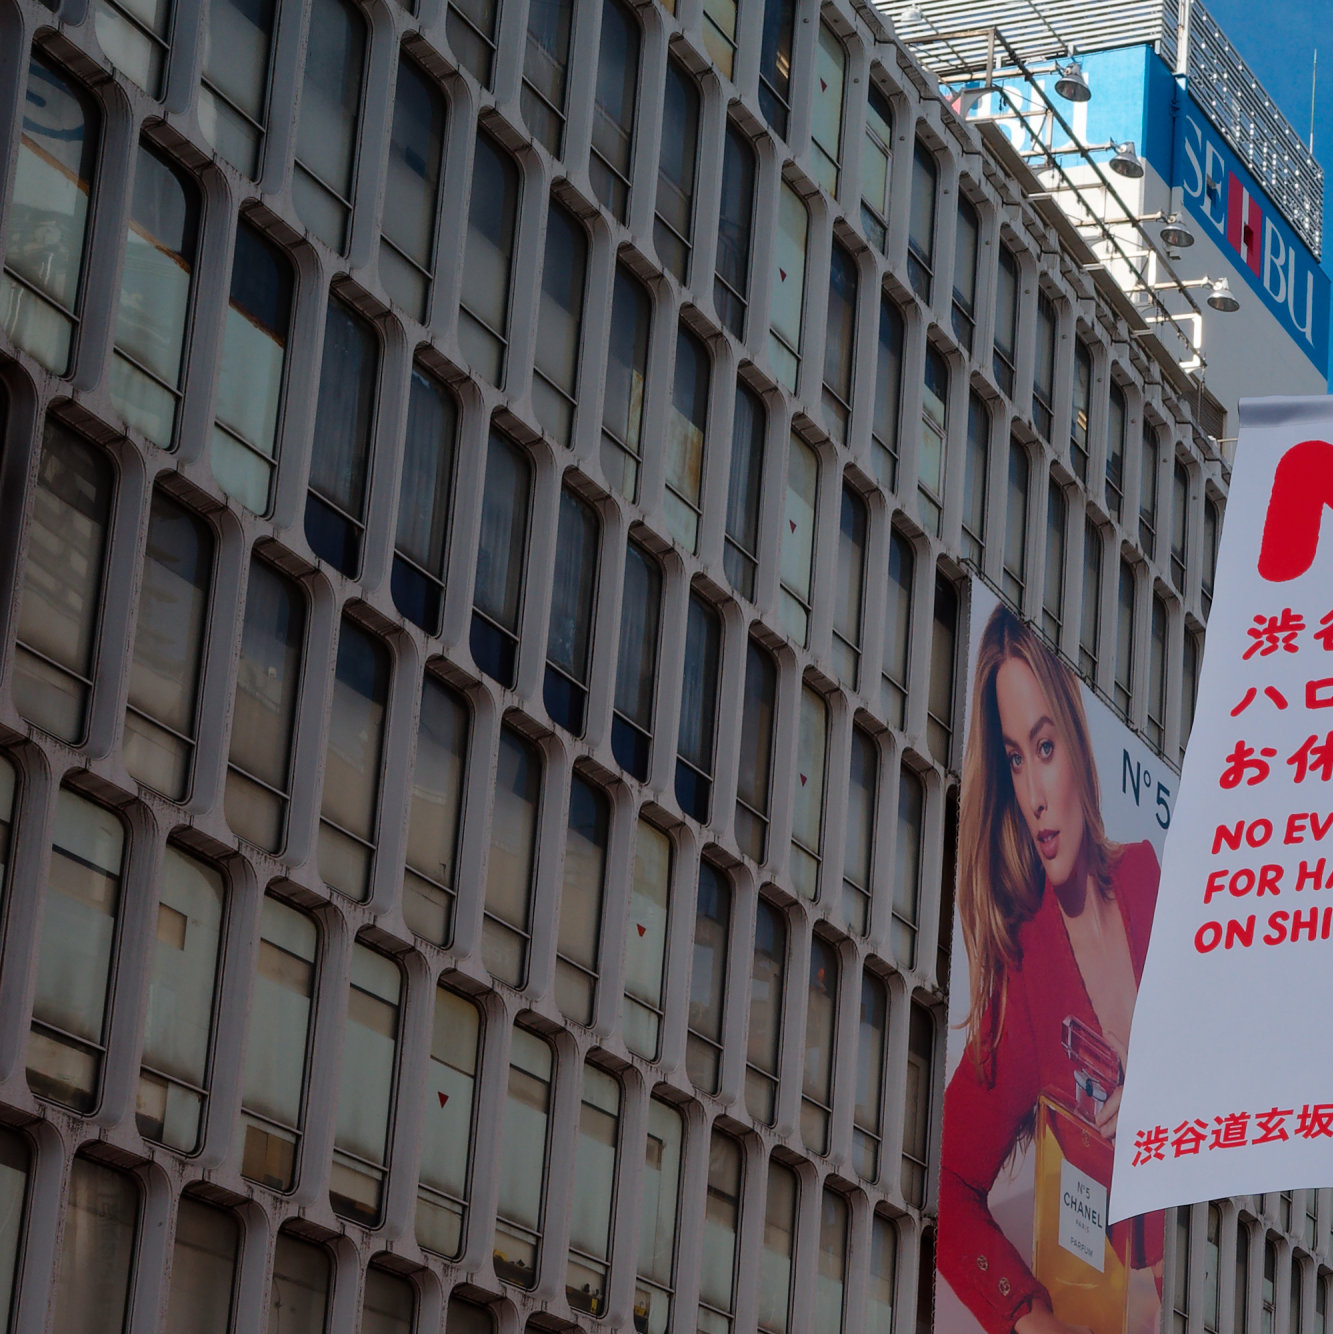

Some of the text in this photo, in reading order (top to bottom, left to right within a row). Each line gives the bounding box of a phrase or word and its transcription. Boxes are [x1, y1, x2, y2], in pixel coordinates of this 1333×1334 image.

[1183, 114, 1314, 348] SEIBU
[1211, 817, 1274, 855] NO
[1204, 863, 1283, 904] FOR
[1194, 915, 1257, 954] ON
[1063, 1191, 1103, 1229] CHANEL
[1070, 1236, 1093, 1256] PARFUM
